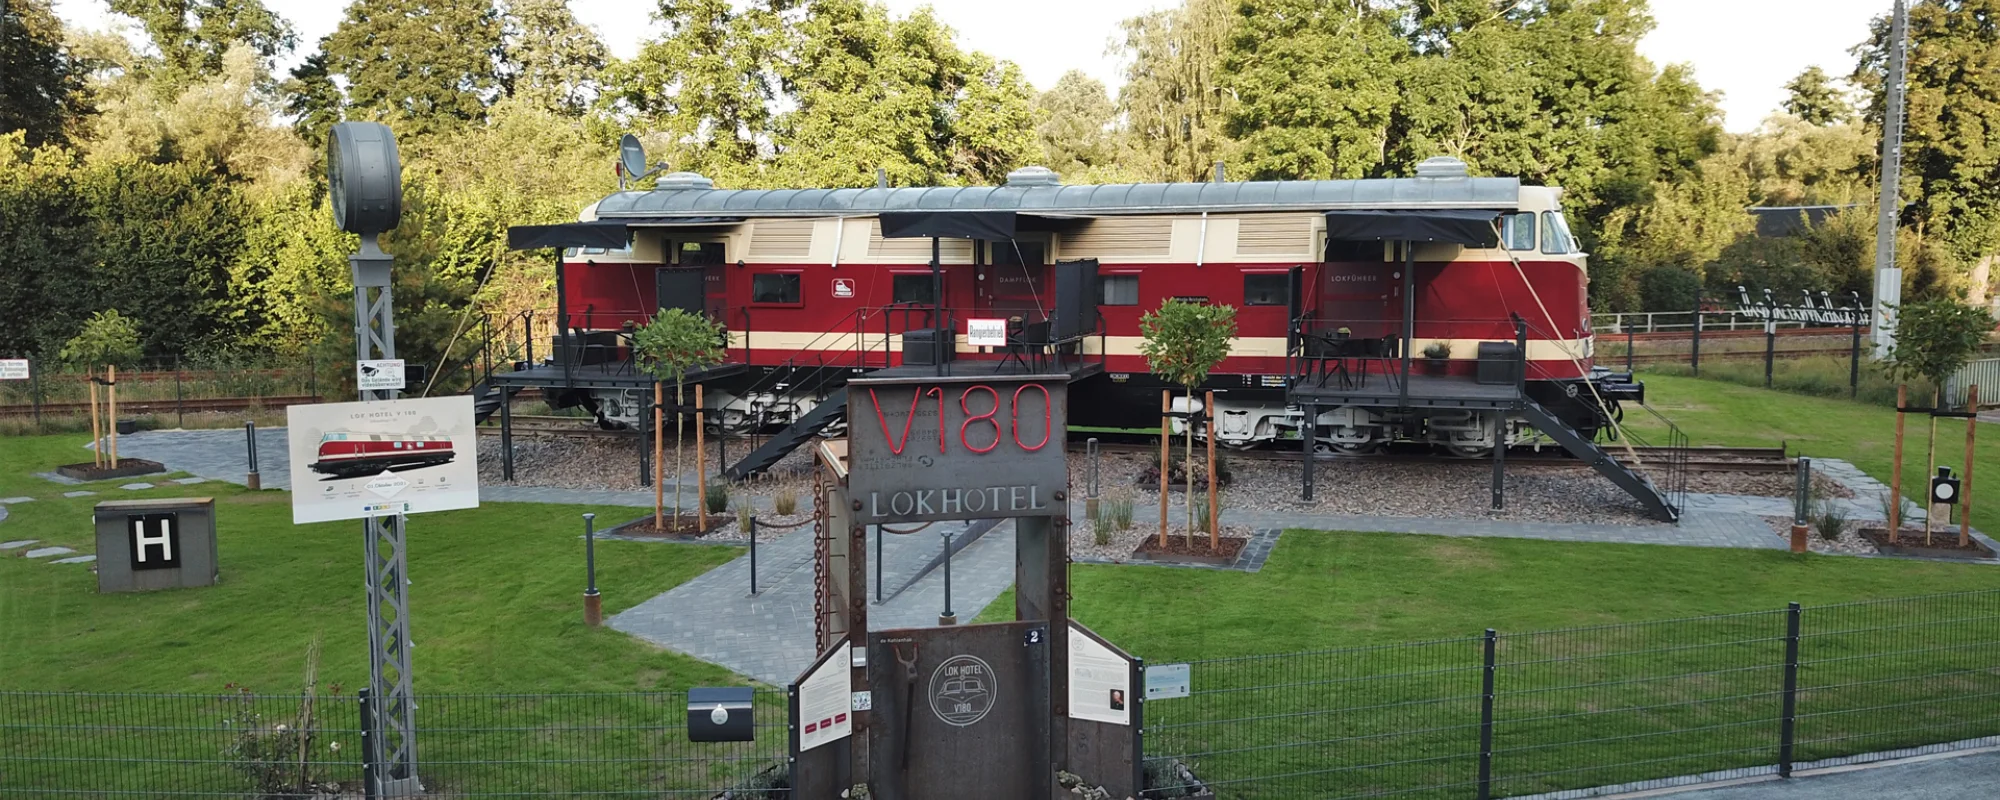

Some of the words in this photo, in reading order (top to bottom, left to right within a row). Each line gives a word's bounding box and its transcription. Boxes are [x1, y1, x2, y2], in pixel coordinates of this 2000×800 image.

[1331, 274, 1377, 282] LOKFÜHRER
[969, 325, 1004, 339] Rangierbetrieb
[869, 383, 1050, 454] V180
[135, 519, 171, 562] H
[1030, 631, 1039, 643] 2
[944, 666, 959, 676] LOK
[960, 664, 982, 675] HOTEL
[953, 703, 972, 712] V180
